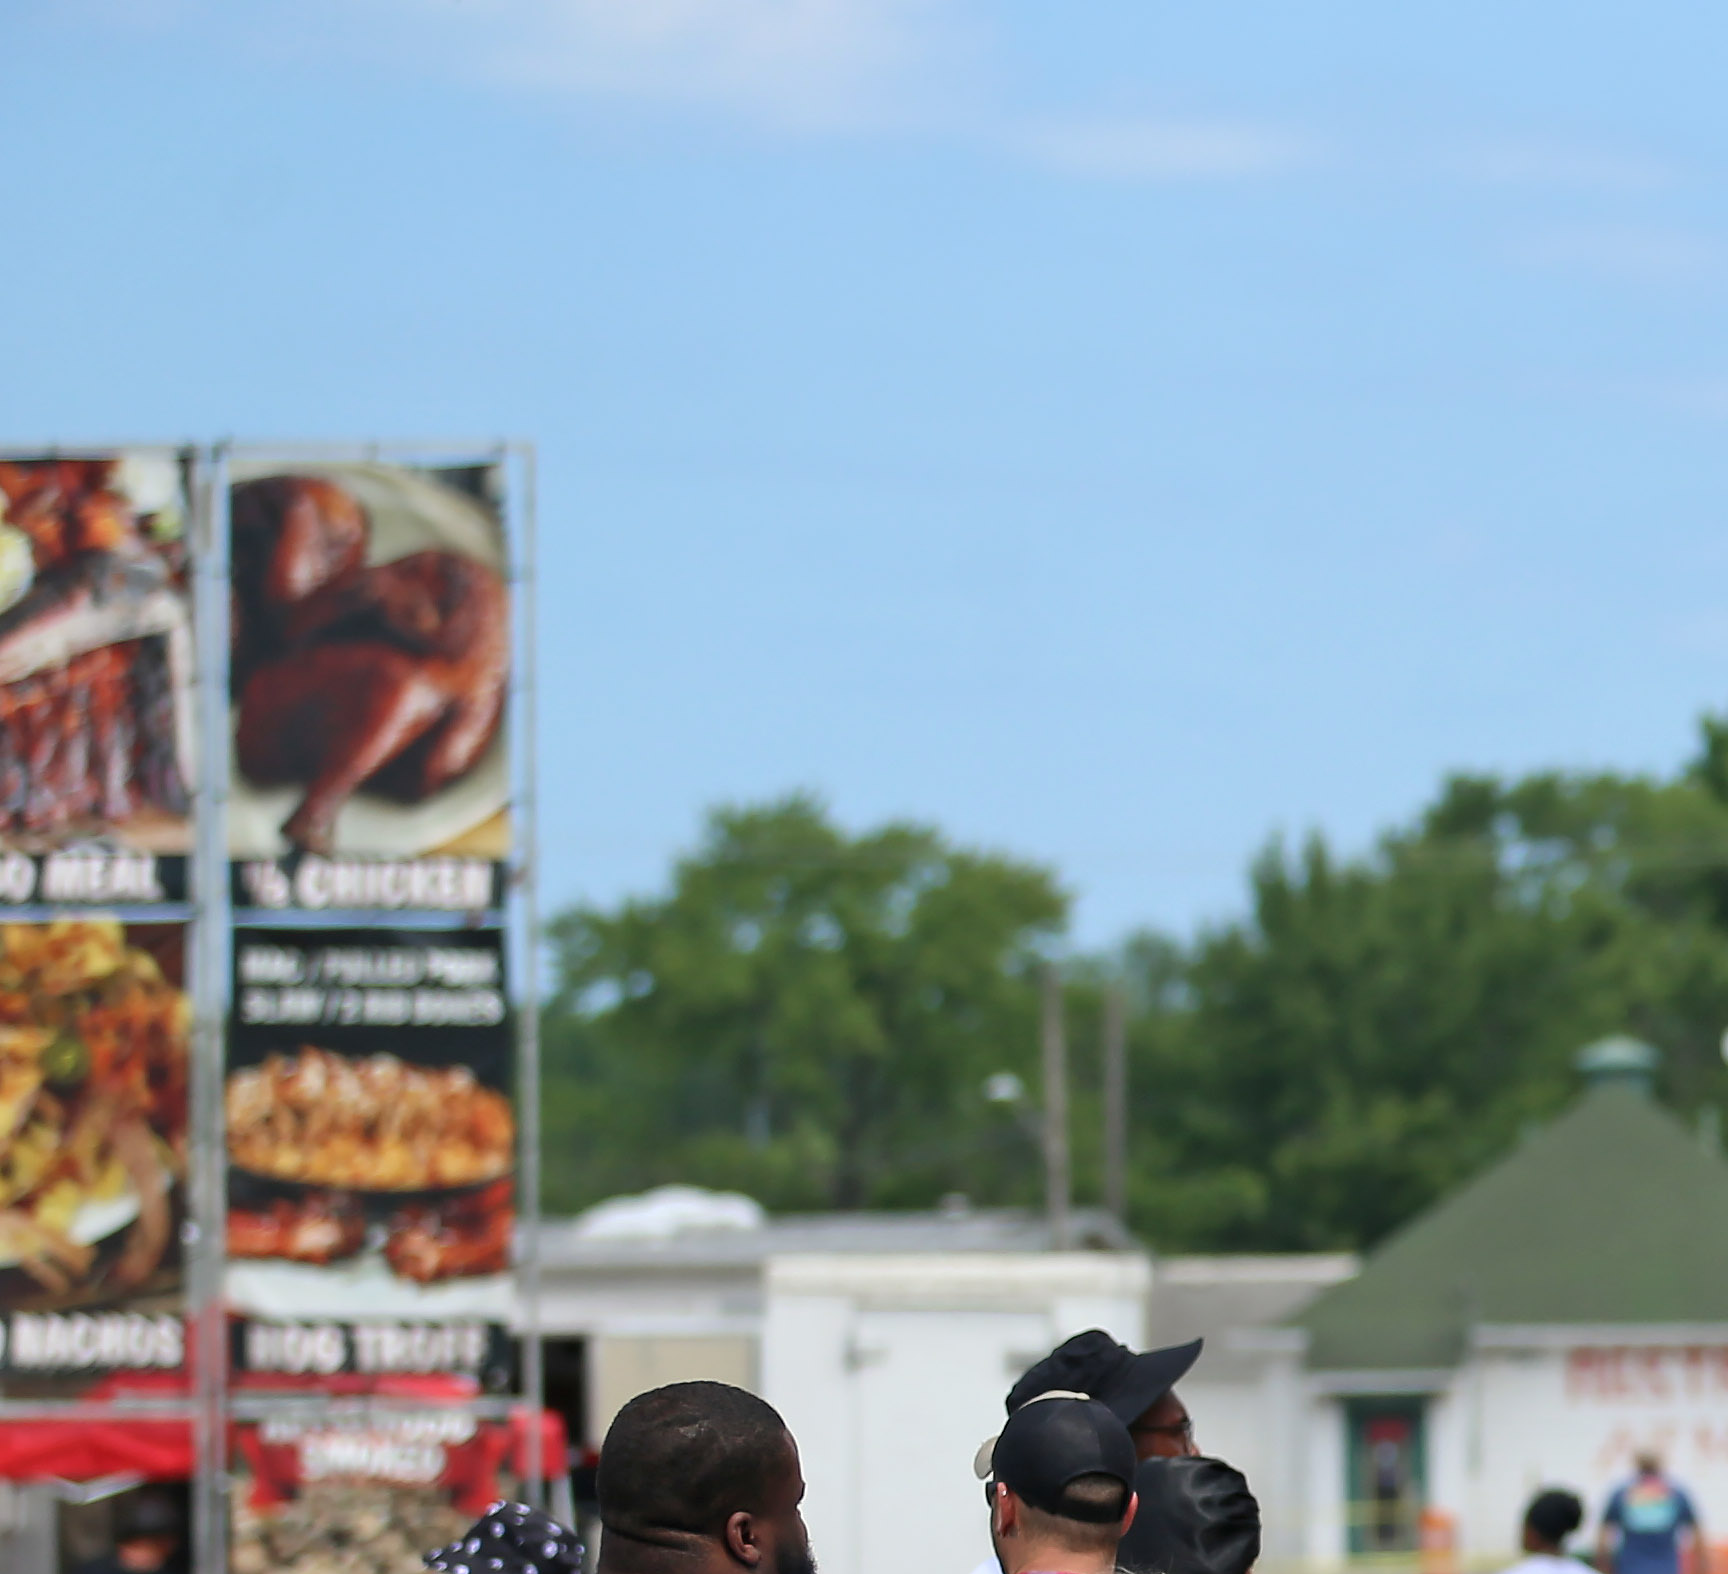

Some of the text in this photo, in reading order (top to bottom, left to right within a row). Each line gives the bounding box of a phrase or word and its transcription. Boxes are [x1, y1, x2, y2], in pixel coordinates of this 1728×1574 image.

[43, 857, 162, 900] MEAL
[296, 858, 494, 908] CHICKEN
[10, 1311, 185, 1369] NACHOS
